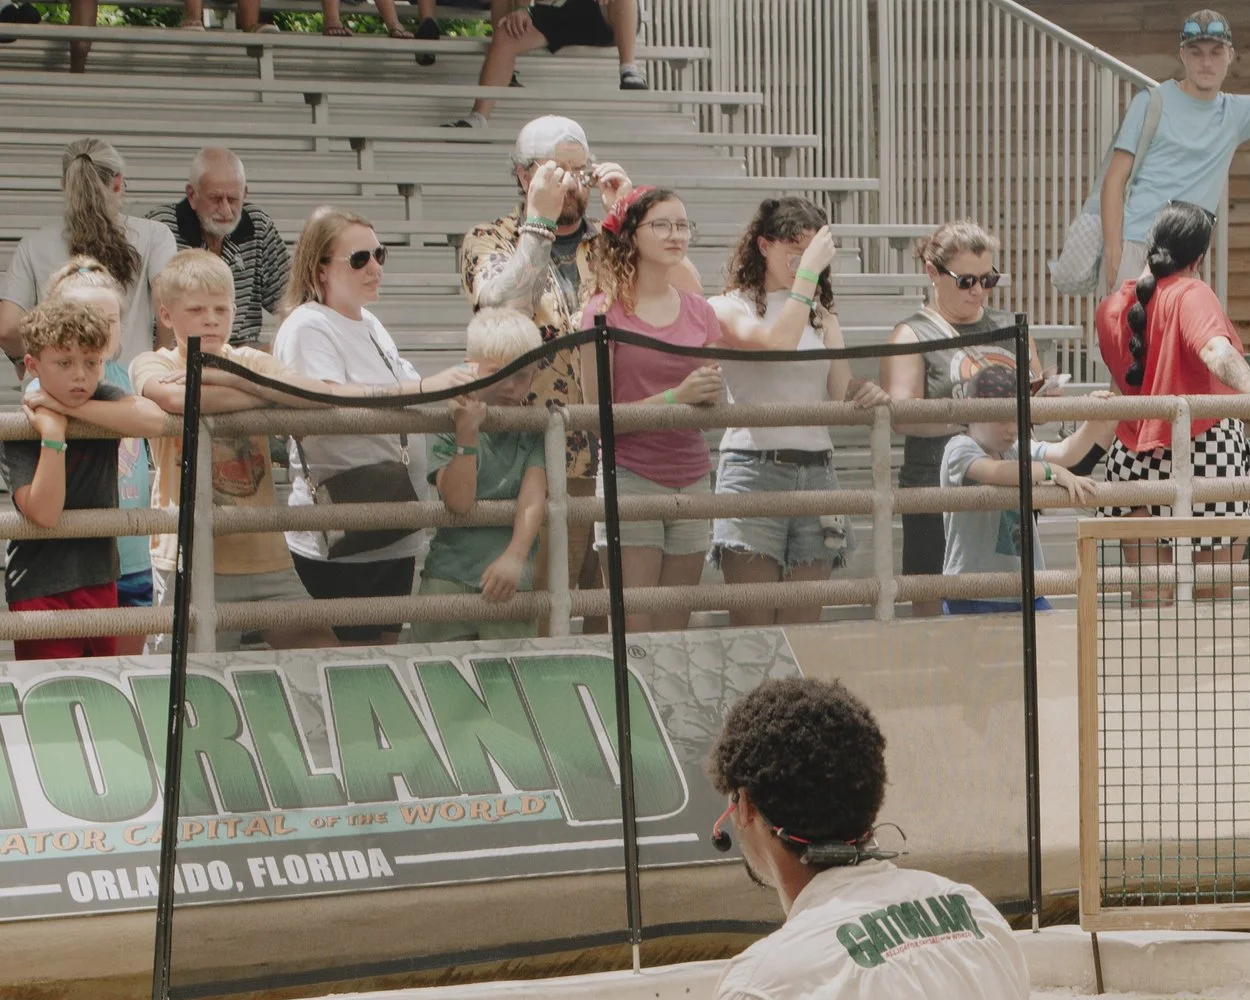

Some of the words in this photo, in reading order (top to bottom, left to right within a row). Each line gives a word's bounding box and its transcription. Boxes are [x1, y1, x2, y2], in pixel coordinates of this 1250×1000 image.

[310, 815, 340, 828] OF
[348, 812, 389, 827] THE
[401, 796, 547, 824] WORLD
[248, 848, 394, 888] FLORIDA
